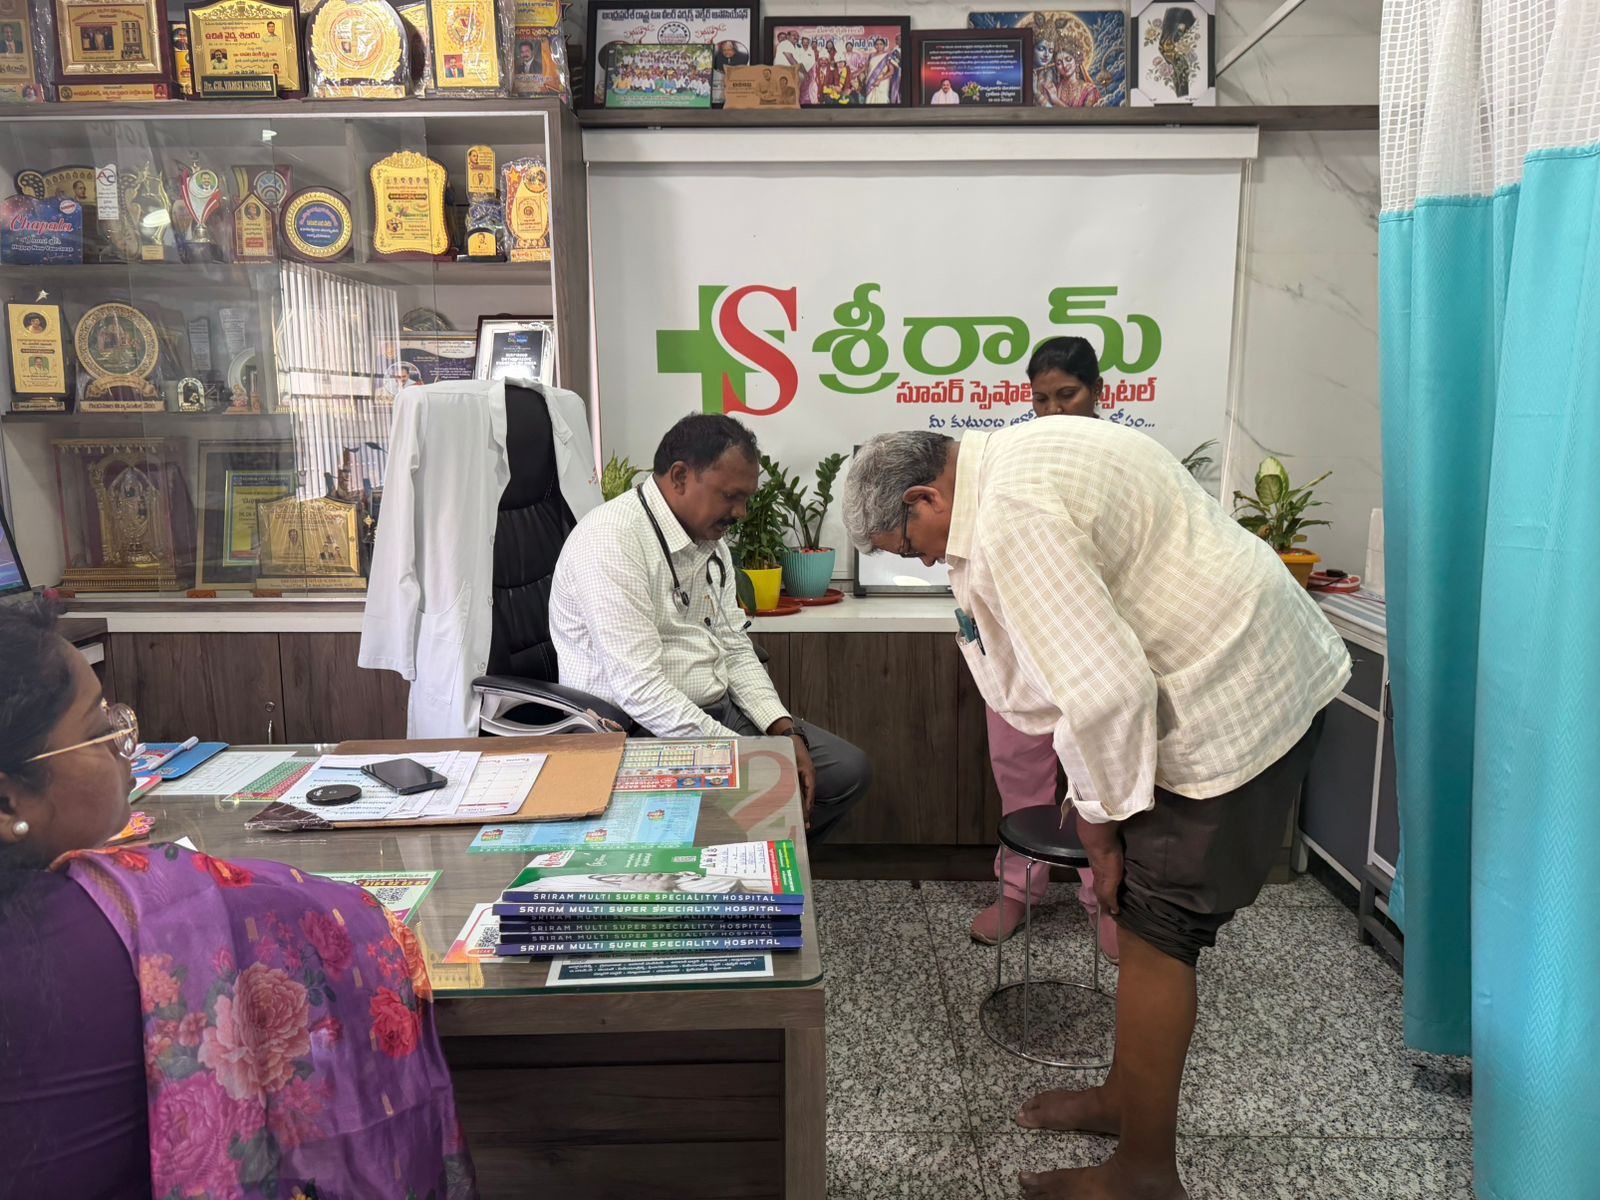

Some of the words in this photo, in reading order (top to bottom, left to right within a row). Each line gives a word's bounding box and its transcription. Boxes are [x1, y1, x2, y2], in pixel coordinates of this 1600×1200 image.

[224, 81, 244, 90] VAMSI
[244, 81, 272, 91] KRISHNA
[719, 285, 798, 416] S
[896, 379, 964, 403] సూపర్
[970, 380, 1033, 410] స్పెషాలి
